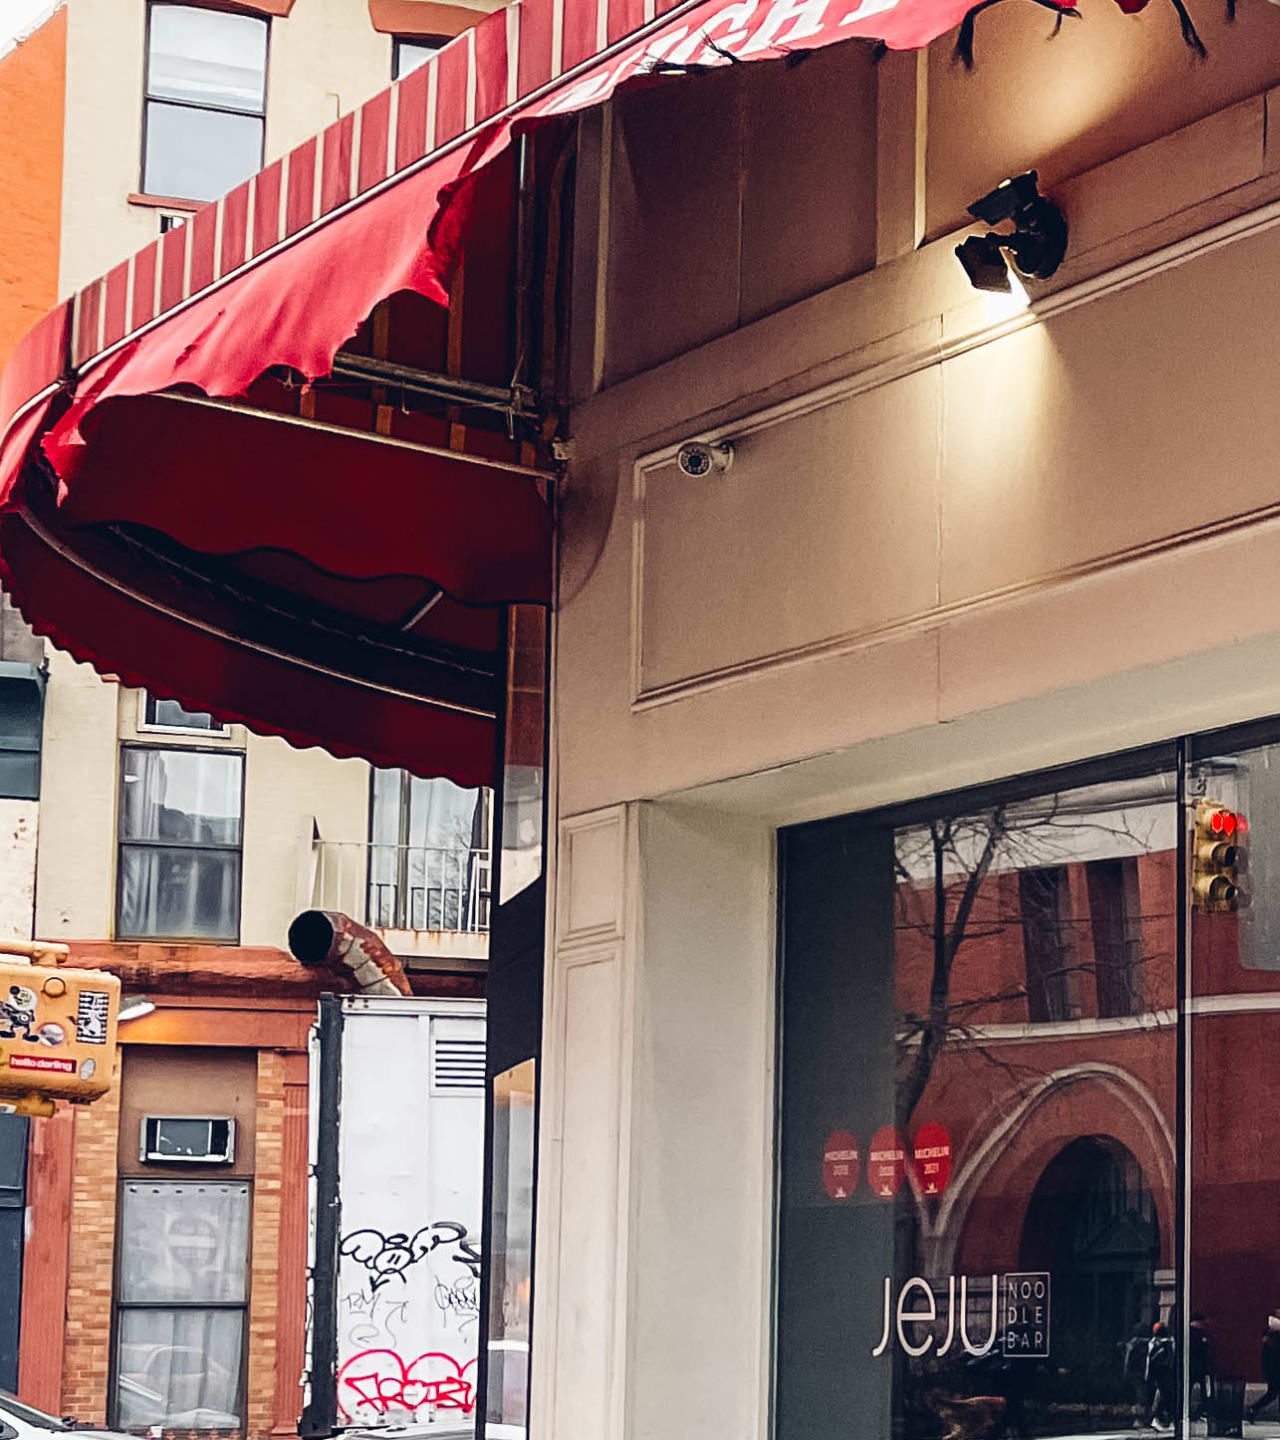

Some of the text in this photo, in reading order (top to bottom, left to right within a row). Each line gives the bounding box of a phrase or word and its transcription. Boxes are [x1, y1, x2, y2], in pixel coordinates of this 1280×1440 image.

[914, 1146, 950, 1159] MICHELIN
[1008, 1281, 1045, 1299] NOO
[1007, 1306, 1043, 1324] DLE
[1007, 1331, 1043, 1349] BAR
